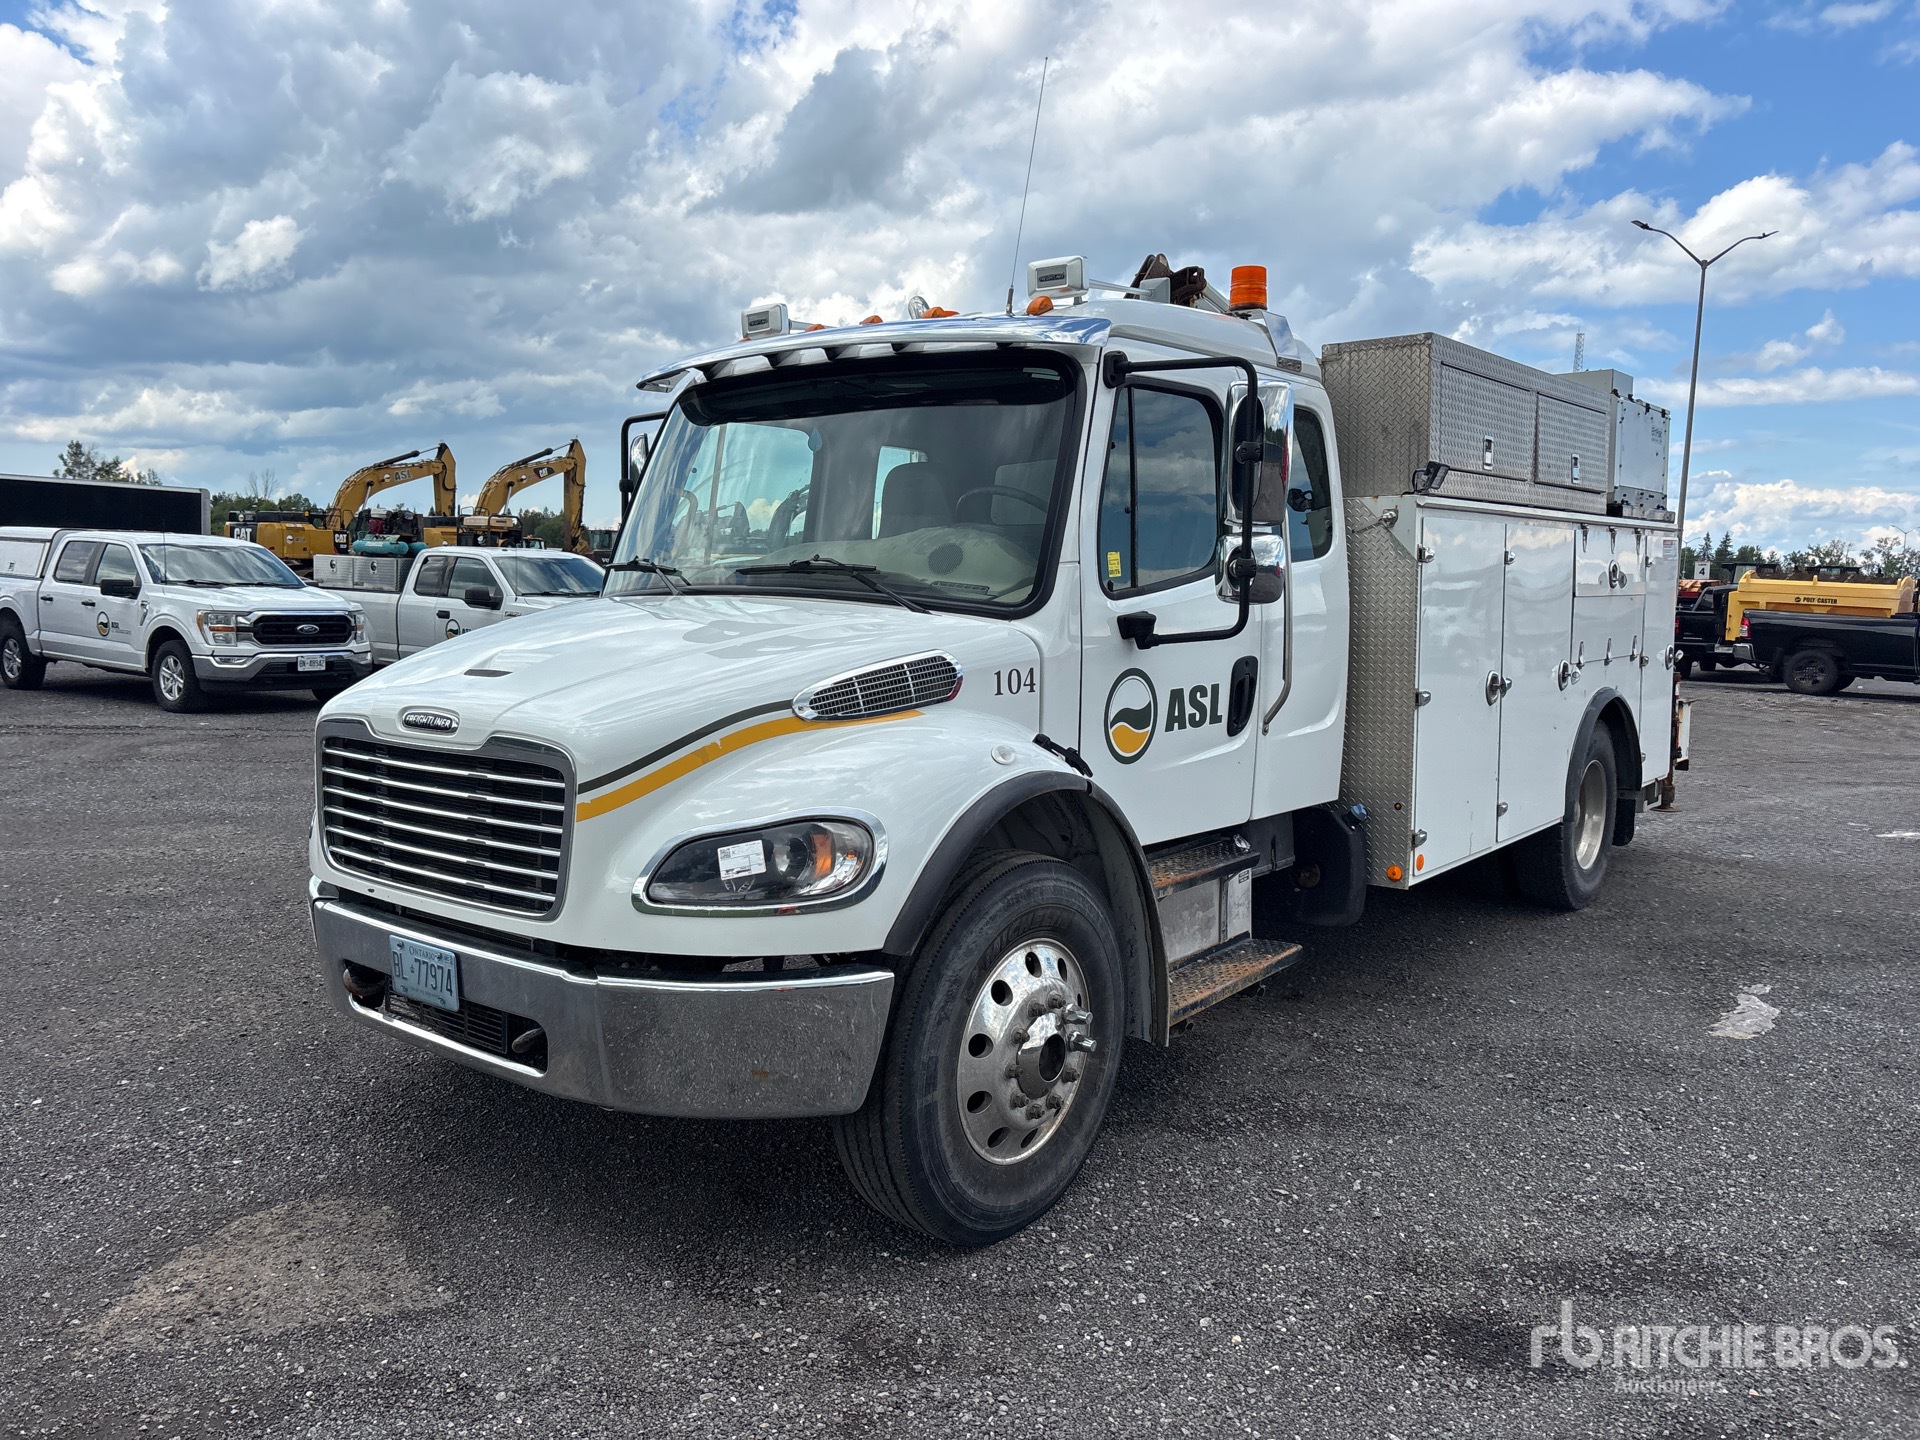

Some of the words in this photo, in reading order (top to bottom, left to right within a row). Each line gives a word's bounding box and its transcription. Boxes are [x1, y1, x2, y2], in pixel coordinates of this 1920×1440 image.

[394, 470, 411, 481] ASL
[539, 468, 549, 477] CAT
[234, 528, 251, 540] CAT
[335, 534, 347, 543] CAT
[1698, 567, 1705, 576] 4
[993, 667, 1037, 696] 104
[1164, 683, 1223, 733] ASL
[405, 714, 452, 729] FREIGHTLINER
[409, 945, 435, 961] ONTARIO
[392, 950, 408, 981] BL
[414, 957, 453, 997] 77974
